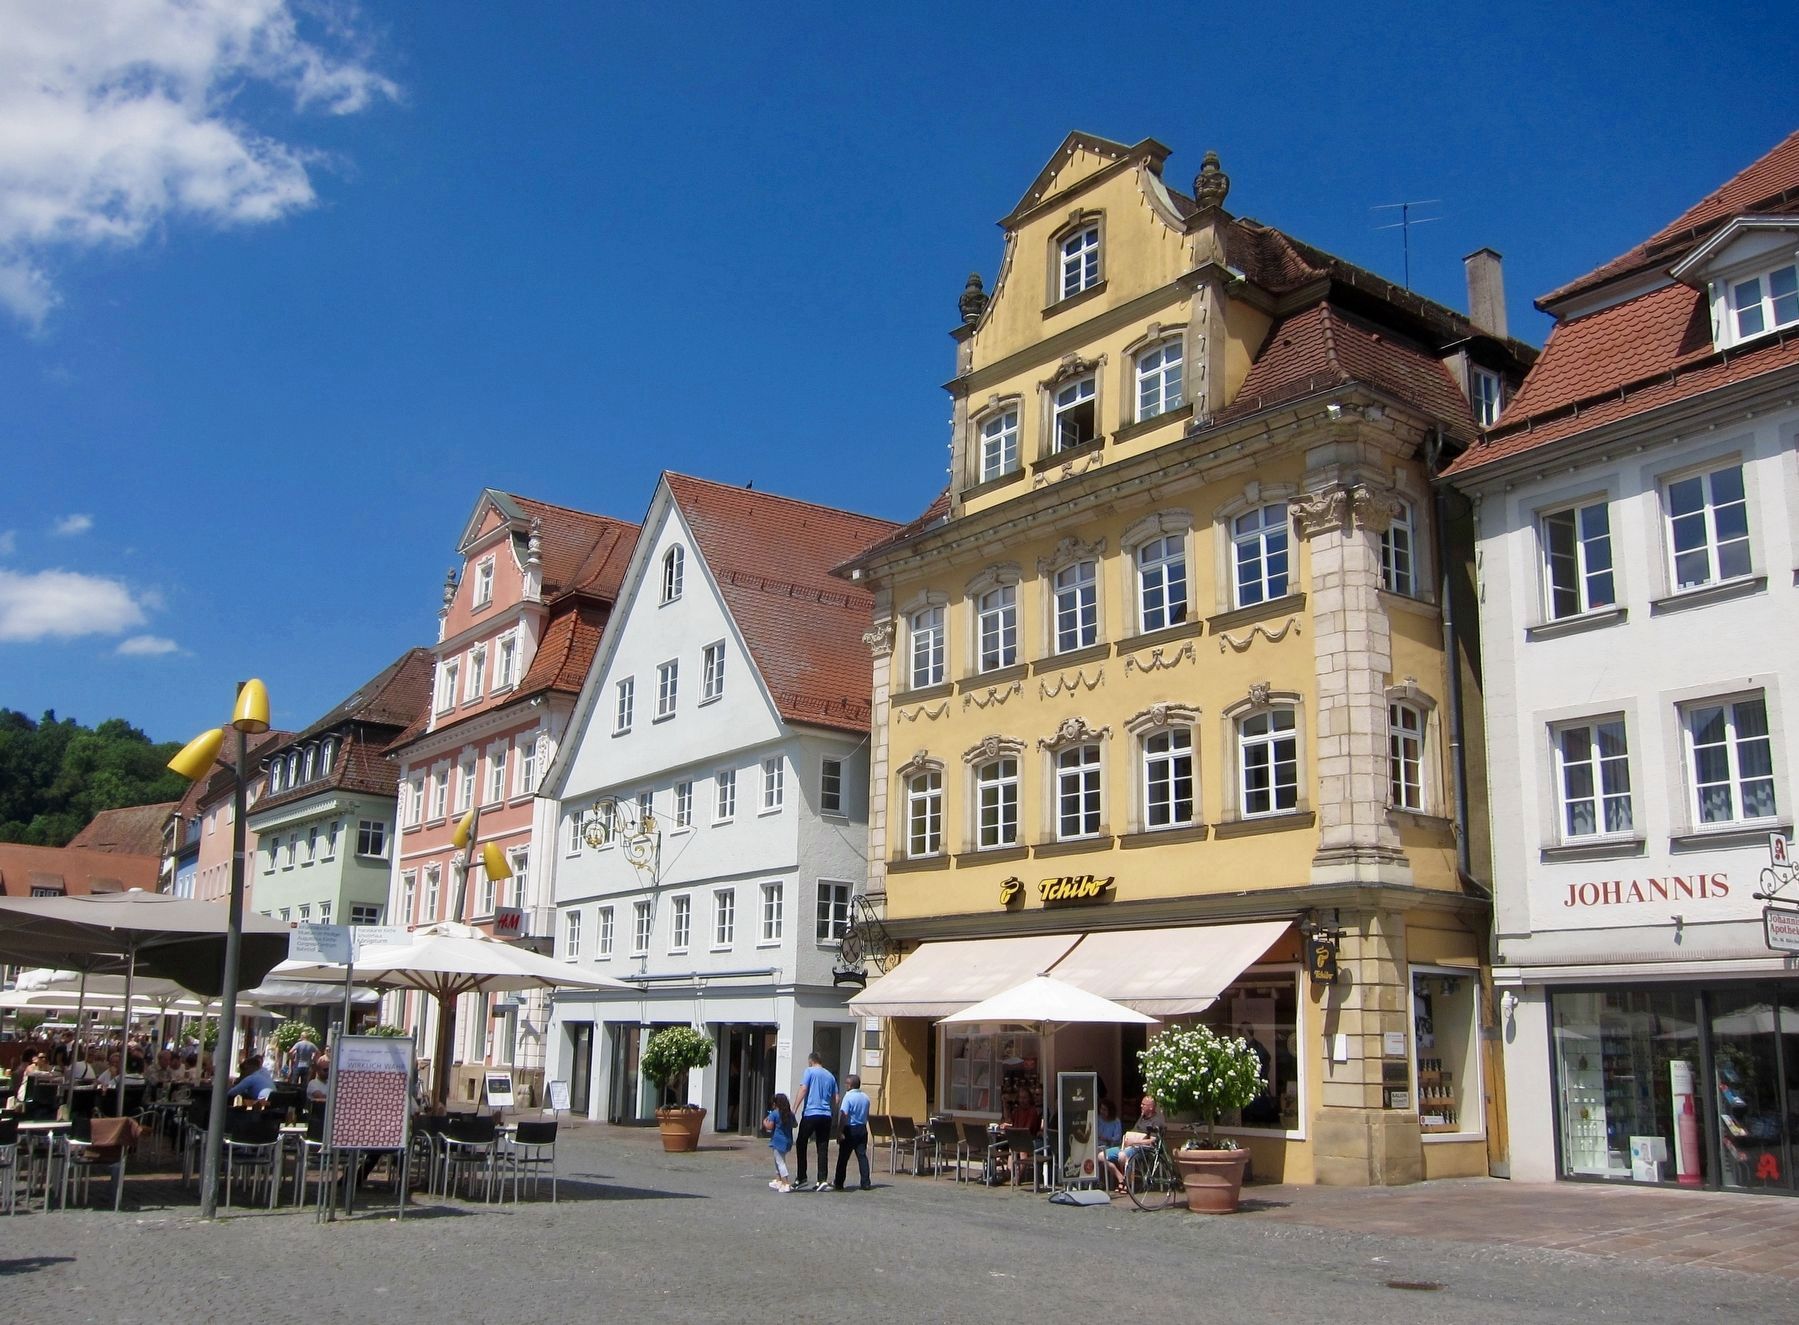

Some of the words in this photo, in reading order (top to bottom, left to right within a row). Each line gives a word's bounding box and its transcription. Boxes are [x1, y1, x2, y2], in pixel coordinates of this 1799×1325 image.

[1038, 875, 1112, 901] Tchibo
[1564, 873, 1730, 907] JOHANNIS
[497, 913, 521, 931] H&M
[347, 1062, 381, 1070] WIRKLICH
